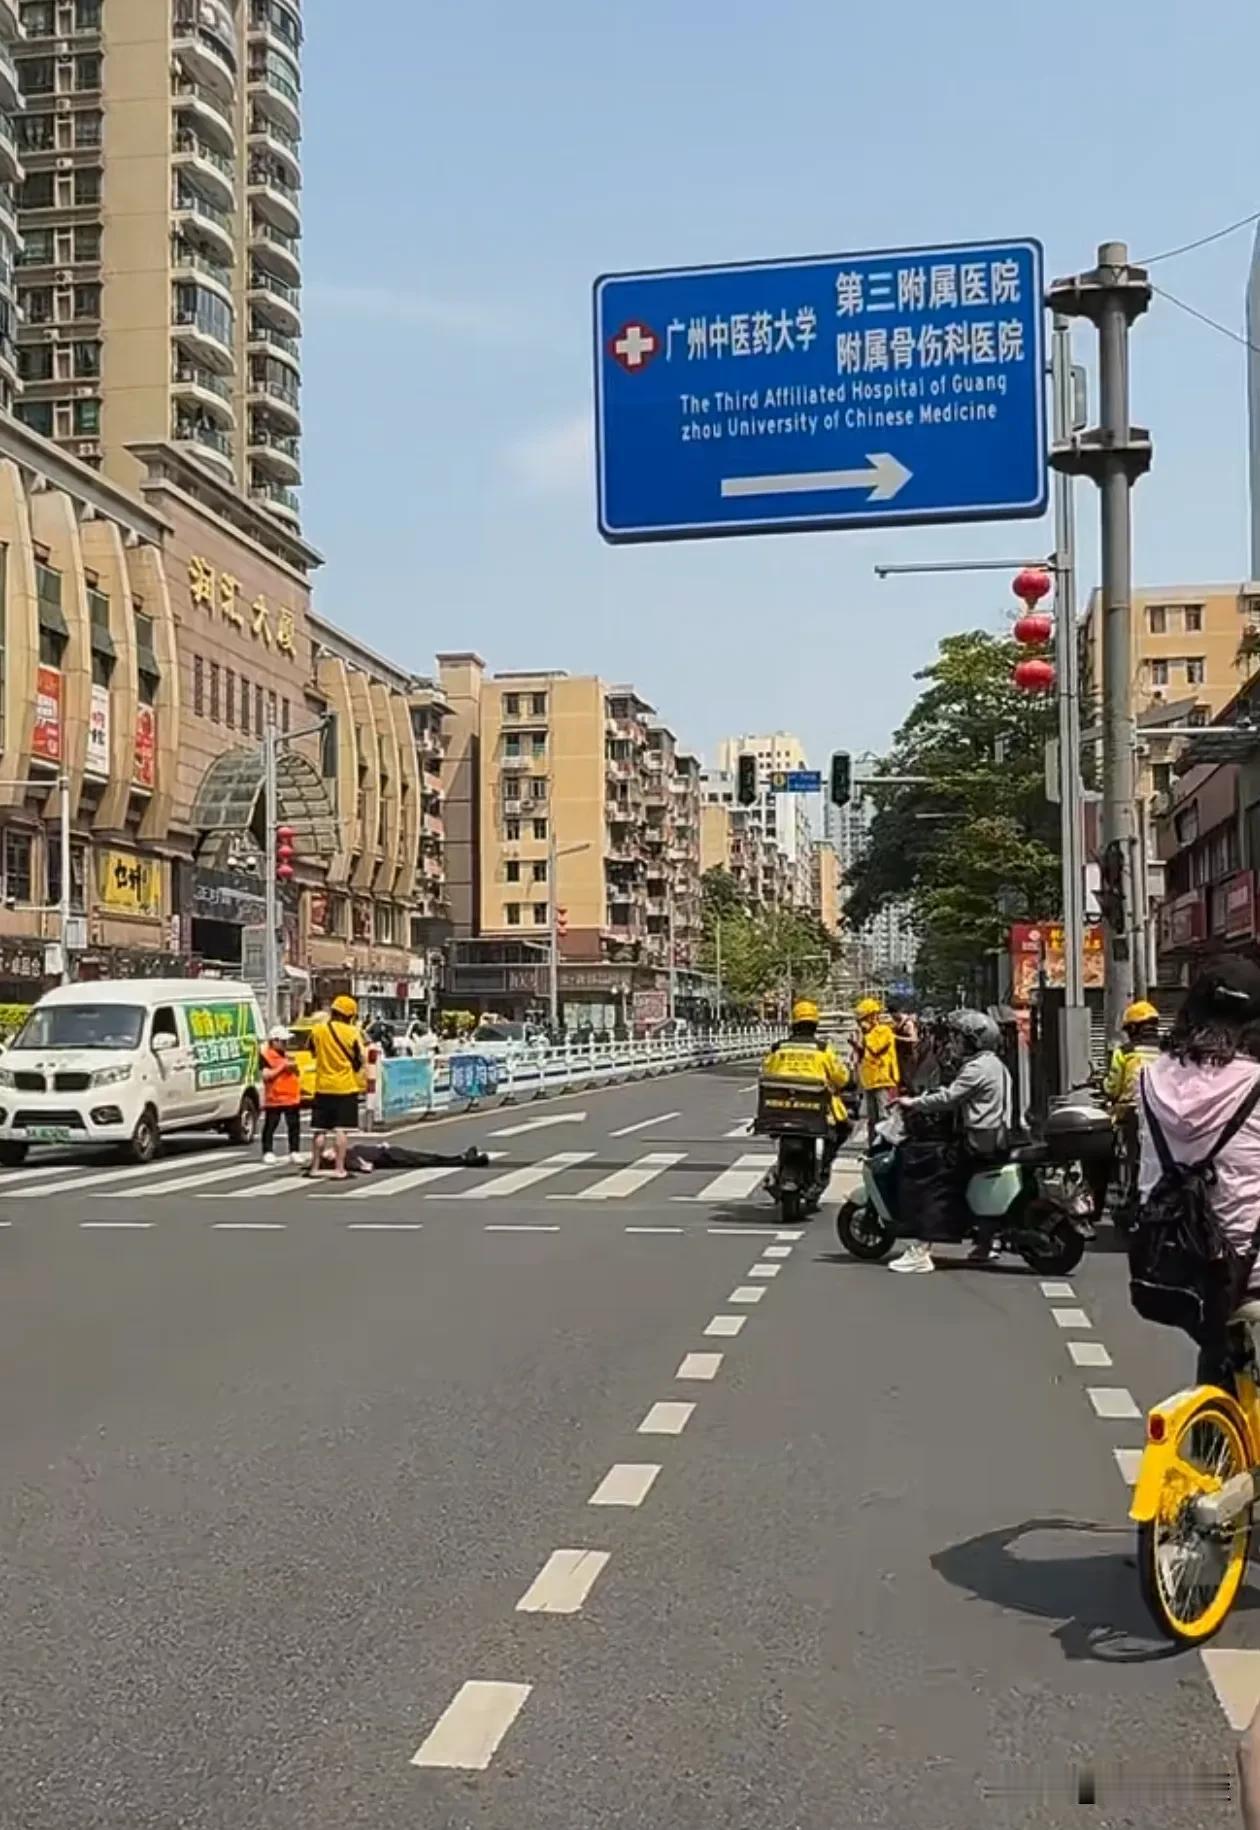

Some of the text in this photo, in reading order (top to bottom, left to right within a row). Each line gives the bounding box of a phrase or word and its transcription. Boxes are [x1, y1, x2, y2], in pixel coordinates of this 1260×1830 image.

[835, 258, 1021, 317] 第三附属医院
[666, 306, 817, 362] 广州中医药大学
[836, 318, 1025, 374] 附属骨伤科医院
[680, 372, 1007, 415] The Third Affiliated Hospital of Guang
[681, 402, 997, 441] zhou University of Chinese Medicine
